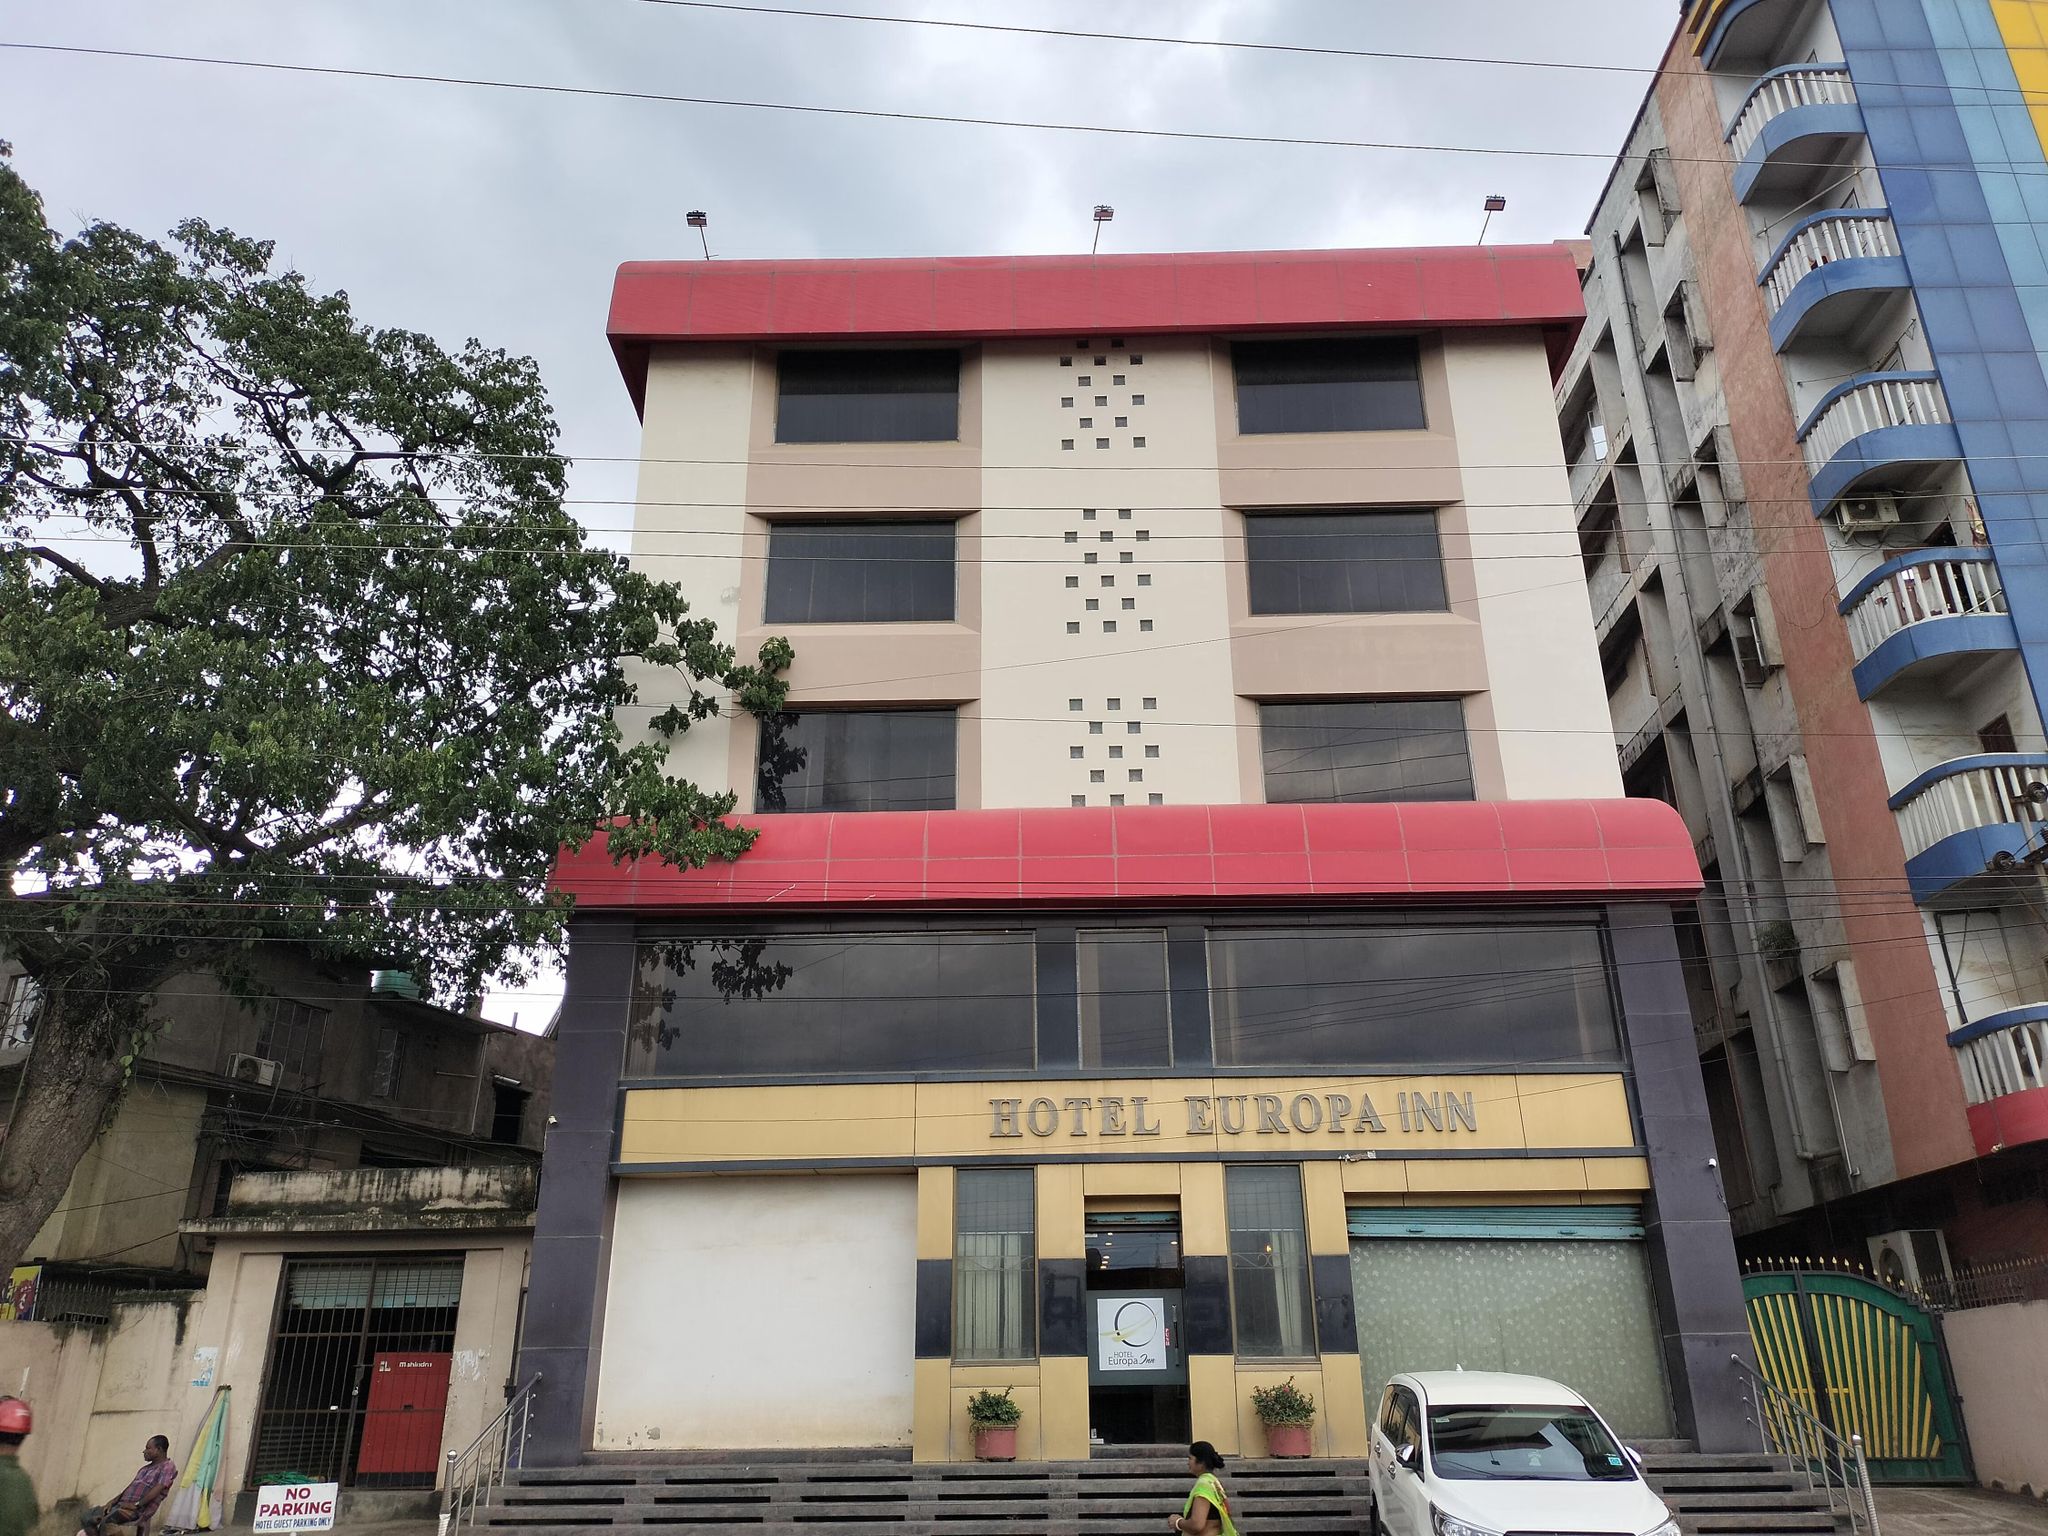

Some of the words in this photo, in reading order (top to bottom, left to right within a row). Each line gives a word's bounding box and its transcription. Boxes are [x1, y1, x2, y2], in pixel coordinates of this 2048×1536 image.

[989, 1096, 1161, 1138] HOTEL
[1184, 1092, 1387, 1136] EUROPA
[1397, 1090, 1478, 1132] INN
[1108, 1356, 1138, 1366] Europa
[1139, 1353, 1155, 1365] Inn
[285, 1487, 311, 1500] NO
[259, 1501, 332, 1517] PARKING
[255, 1520, 273, 1530] HOTEL
[273, 1519, 293, 1529] GUEST
[293, 1518, 318, 1528] PARKING
[318, 1516, 331, 1526] ONLY
